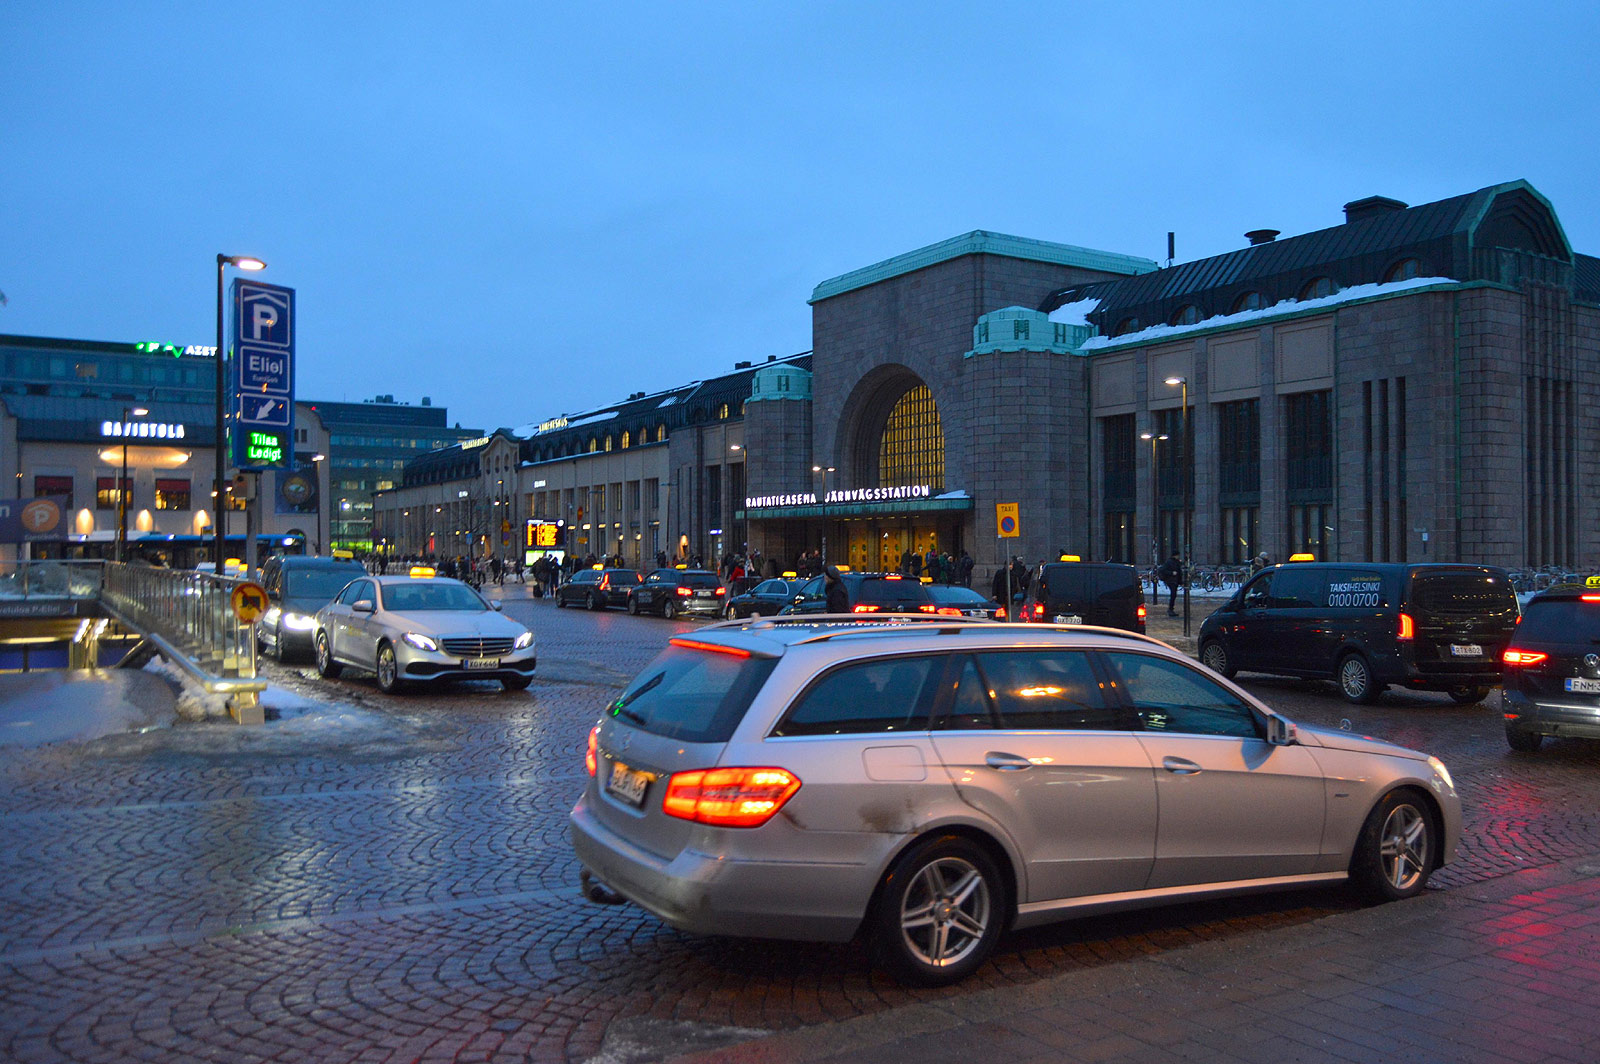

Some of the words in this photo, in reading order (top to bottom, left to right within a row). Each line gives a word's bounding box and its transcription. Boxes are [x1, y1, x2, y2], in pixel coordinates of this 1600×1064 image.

[250, 356, 283, 375] Eliel
[248, 446, 282, 462] Ledigt
[1328, 593, 1352, 607] 0100
[1352, 592, 1379, 607] 0700
